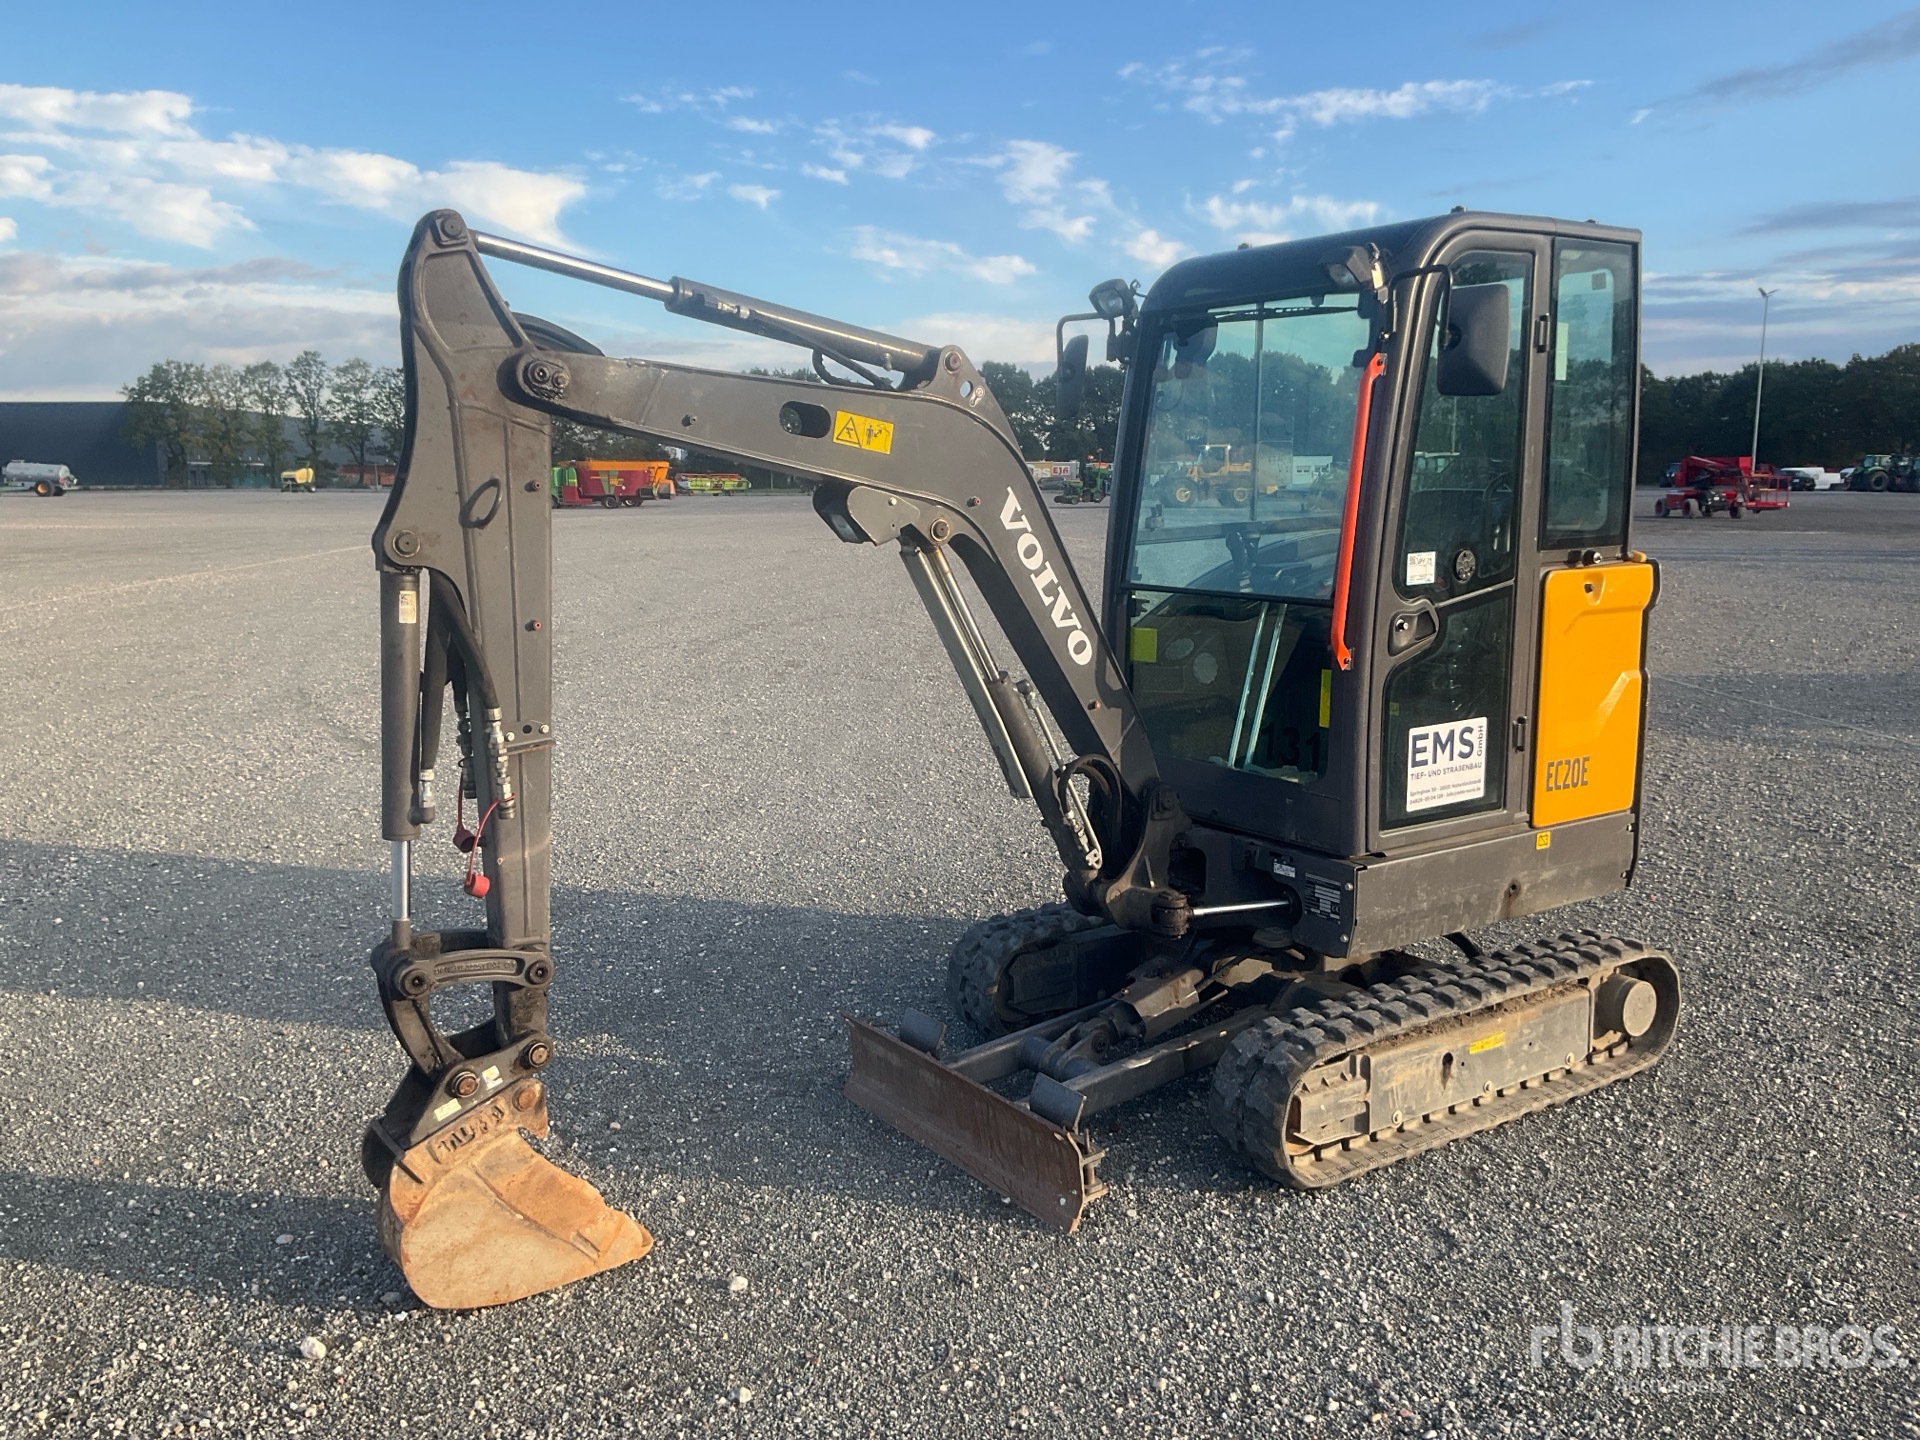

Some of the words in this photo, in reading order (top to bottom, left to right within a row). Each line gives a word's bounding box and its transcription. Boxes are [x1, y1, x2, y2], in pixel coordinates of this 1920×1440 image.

[1000, 486, 1092, 666] VOLVO
[1261, 722, 1321, 771] 131
[1411, 726, 1474, 768] EMS
[1428, 768, 1442, 778] UND
[1546, 756, 1590, 792] EC20E
